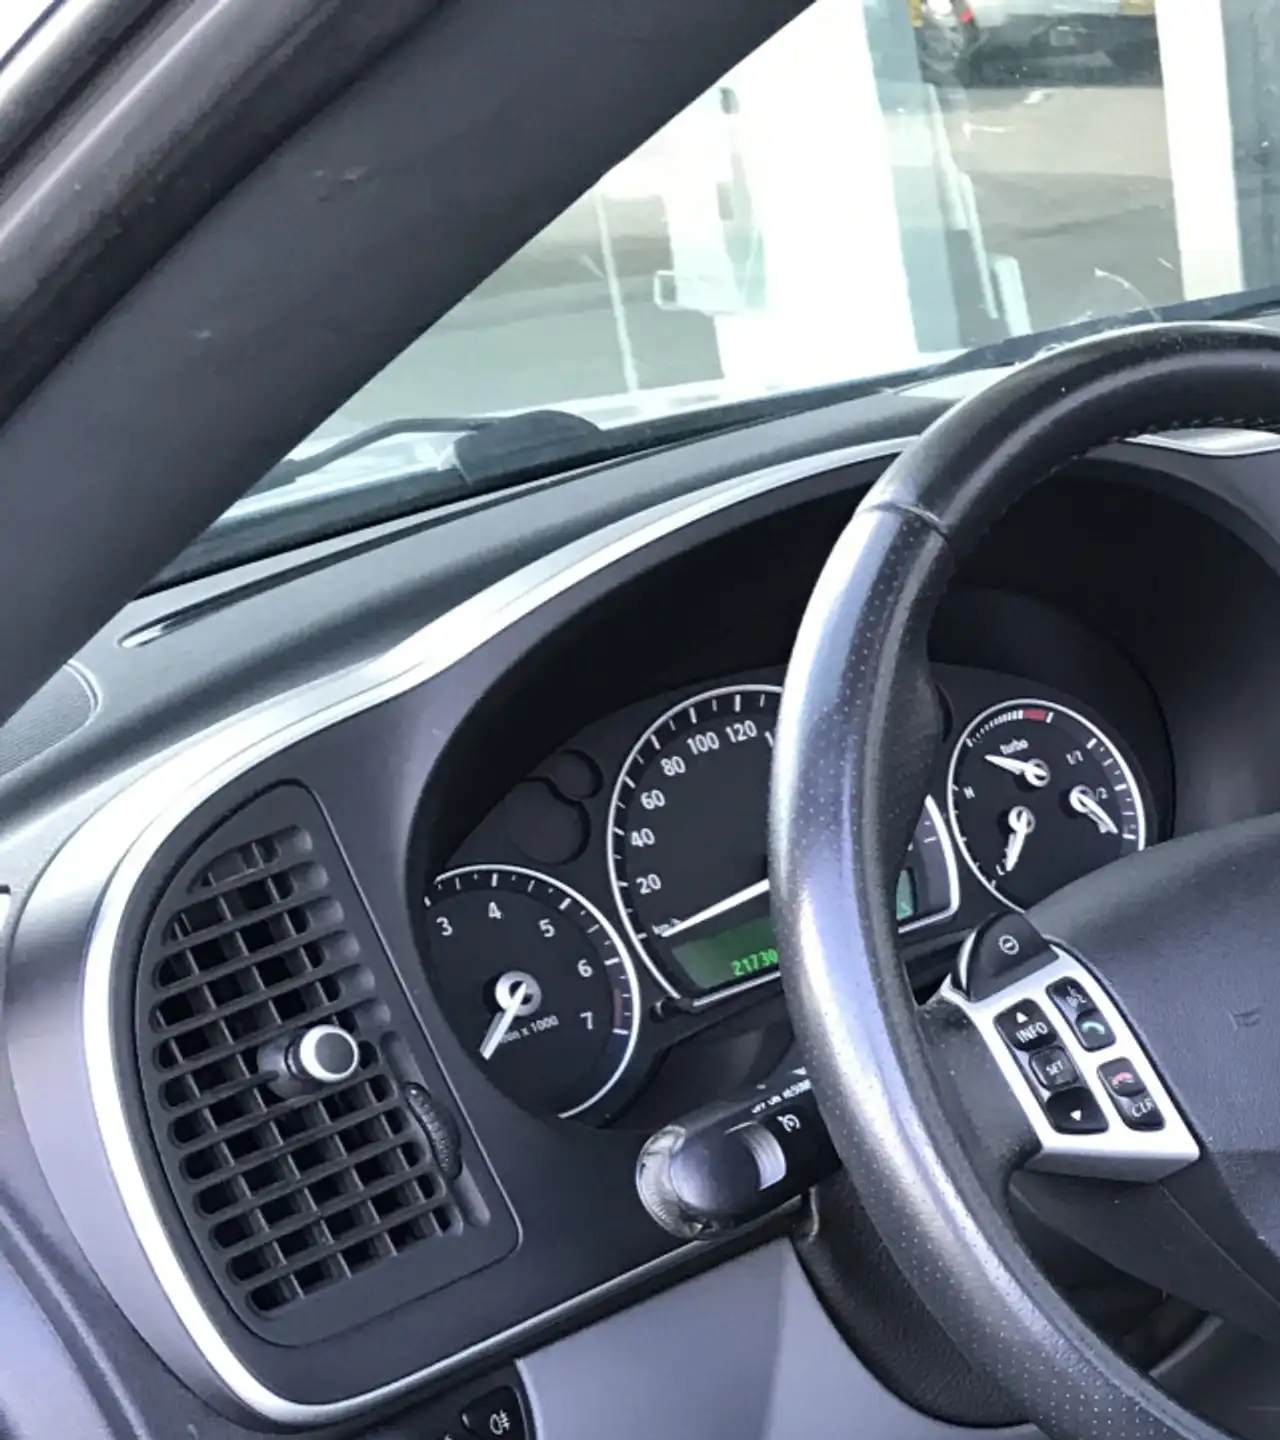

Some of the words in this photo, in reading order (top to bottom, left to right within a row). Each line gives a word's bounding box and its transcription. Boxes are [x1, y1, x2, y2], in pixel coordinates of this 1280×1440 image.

[725, 720, 757, 743] 120
[686, 732, 719, 755] 100
[1000, 739, 1029, 755] turbo
[660, 756, 686, 776] 80
[640, 789, 666, 810] 60
[630, 827, 655, 847] 40
[636, 873, 661, 894] 20
[487, 901, 503, 920] 4
[436, 917, 453, 936] 3
[538, 918, 556, 938] 5
[577, 960, 593, 977] 6
[530, 1015, 559, 1033] 1000
[580, 1011, 594, 1030] 7
[1015, 1022, 1048, 1044] INFO
[1046, 1061, 1064, 1075] SET
[1131, 1097, 1154, 1118] CLR
